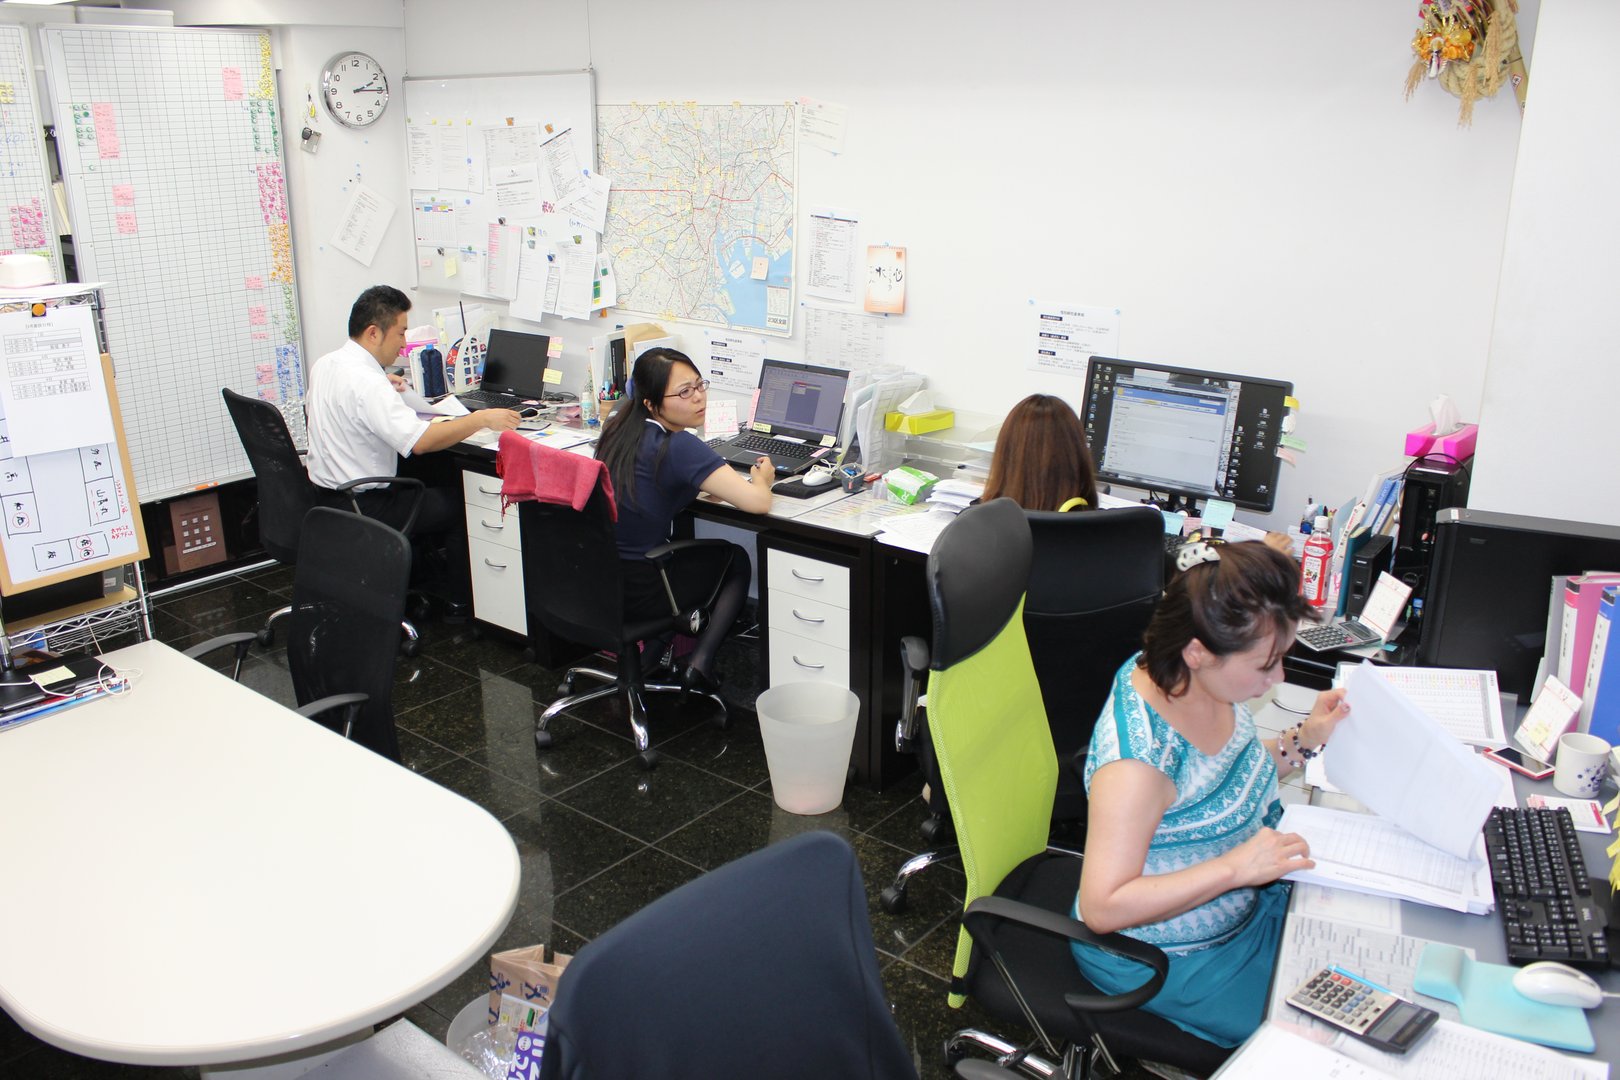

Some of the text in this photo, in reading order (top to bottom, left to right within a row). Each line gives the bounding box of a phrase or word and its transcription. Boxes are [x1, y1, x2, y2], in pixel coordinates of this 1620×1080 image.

[333, 74, 341, 82] 10
[372, 73, 379, 81] 2
[376, 86, 383, 94] 3
[335, 101, 343, 109] 8
[345, 111, 351, 119] 7
[356, 114, 363, 122] 6
